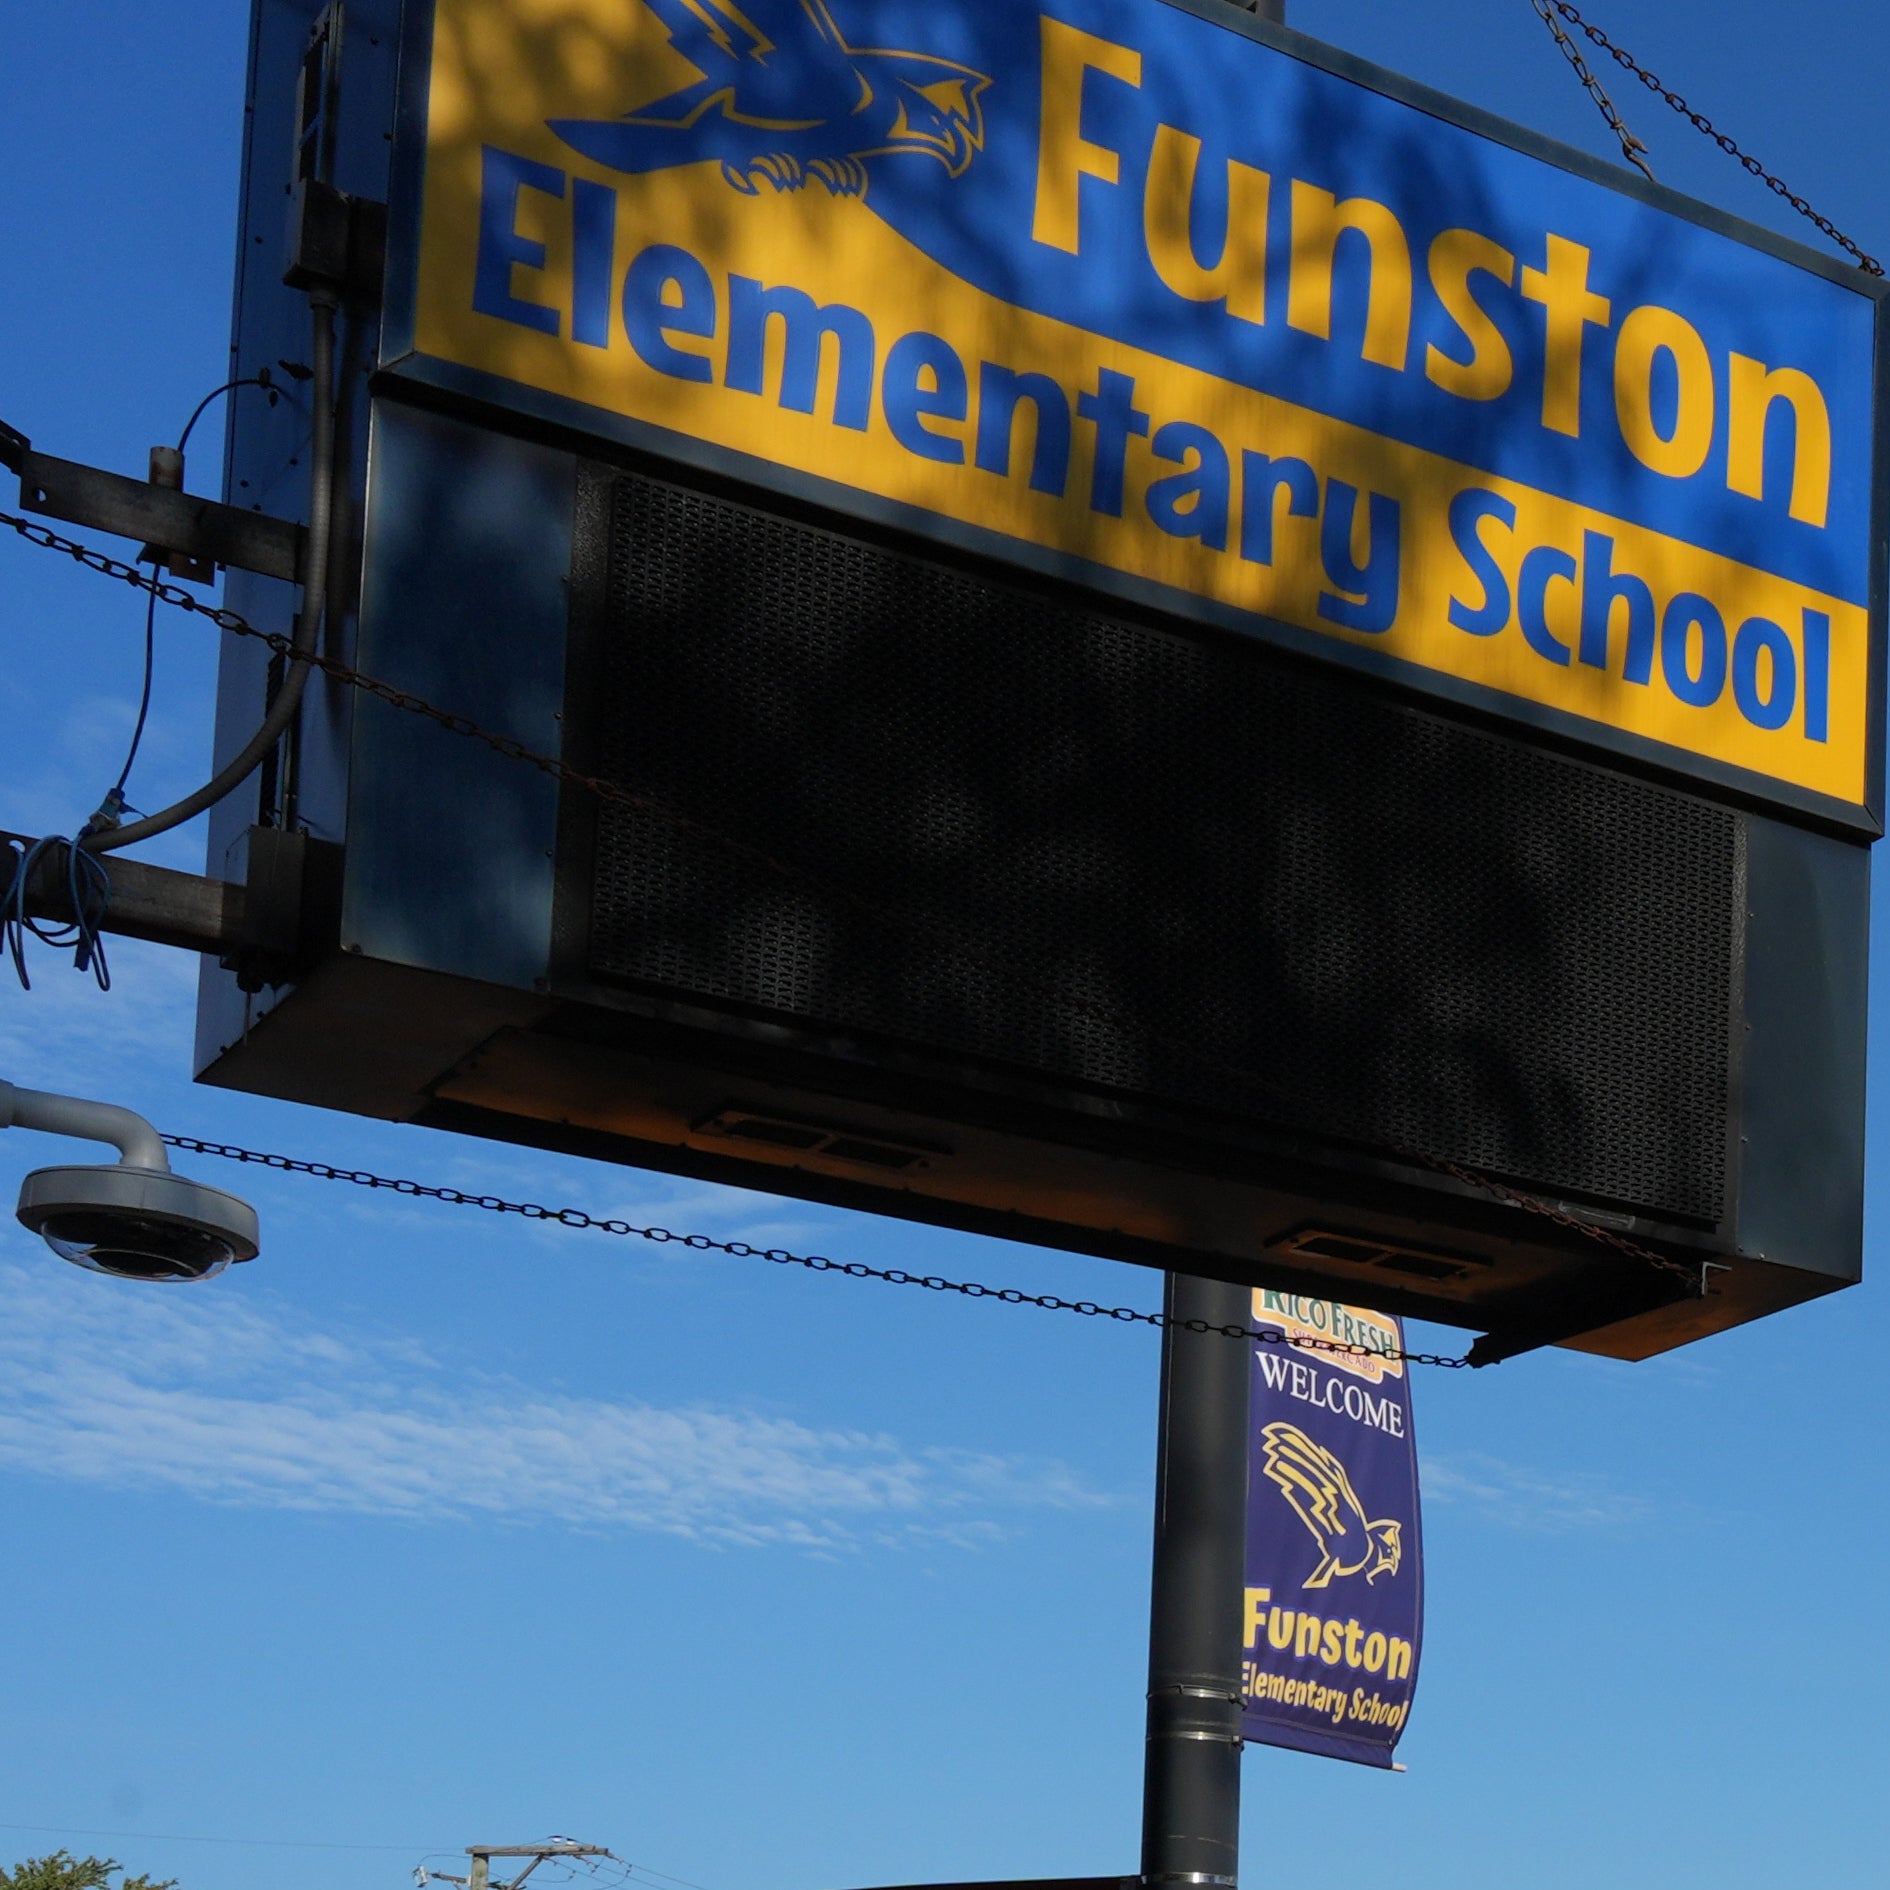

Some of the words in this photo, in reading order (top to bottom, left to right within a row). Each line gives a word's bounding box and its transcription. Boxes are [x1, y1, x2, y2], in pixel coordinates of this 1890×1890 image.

[1033, 14, 1832, 531] Funston
[472, 145, 1402, 636] Elementary
[1447, 486, 1831, 745] School
[1331, 1301, 1395, 1354] FRESH
[1255, 1350, 1404, 1438] WELCOME
[1243, 1587, 1412, 1680] Funston
[1240, 1661, 1346, 1724] Elementary
[1349, 1691, 1408, 1731] School
